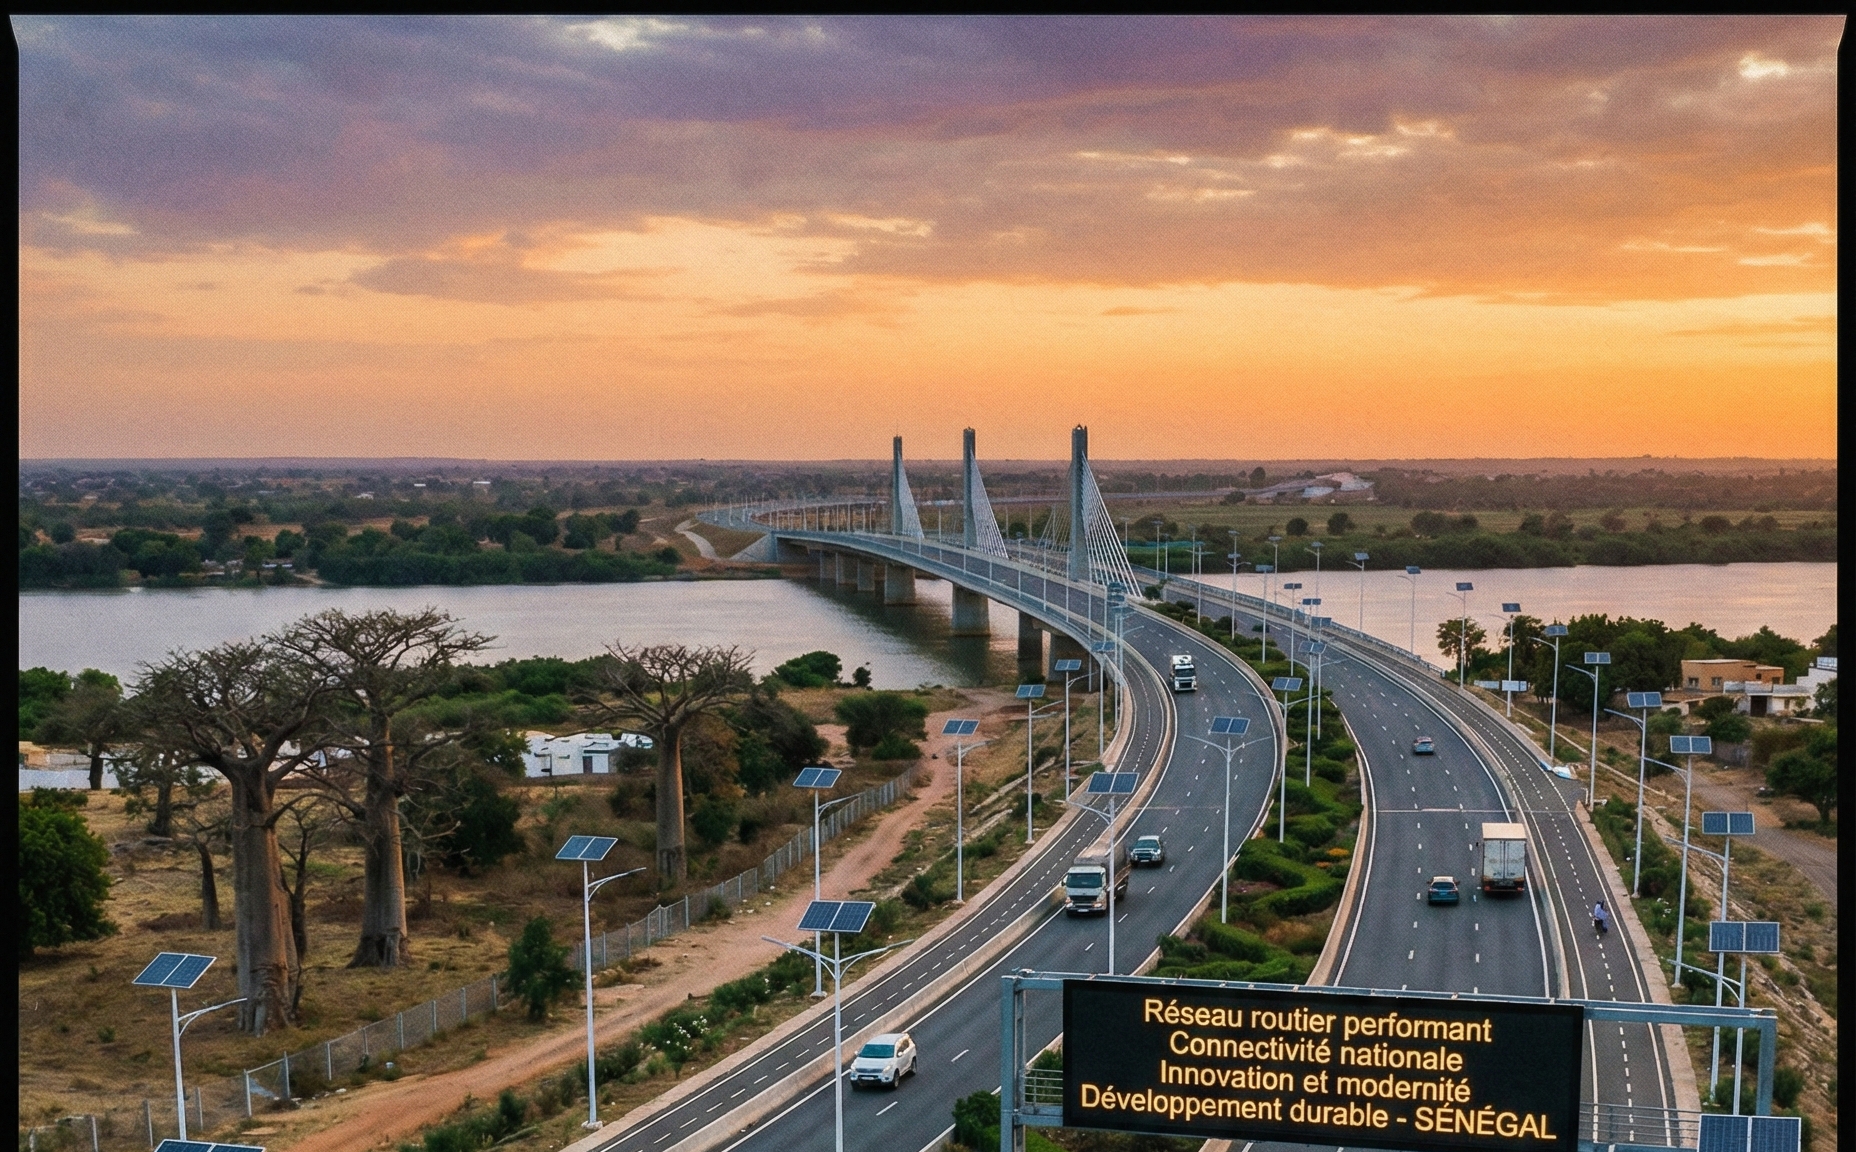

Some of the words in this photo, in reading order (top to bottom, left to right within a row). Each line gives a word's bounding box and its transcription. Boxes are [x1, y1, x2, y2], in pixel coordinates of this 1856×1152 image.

[1144, 998, 1243, 1028] Réseau
[1251, 1006, 1337, 1034] routier
[1343, 1011, 1493, 1043] performant
[1169, 1030, 1332, 1064] Connectivité
[1340, 1042, 1464, 1072] nationale
[1160, 1059, 1294, 1092] Innovation
[1302, 1069, 1329, 1094] et
[1336, 1073, 1471, 1103] modernité
[1081, 1083, 1283, 1122] Développement
[1289, 1098, 1389, 1129] durable
[1414, 1101, 1557, 1140] SÉNÉGAL
